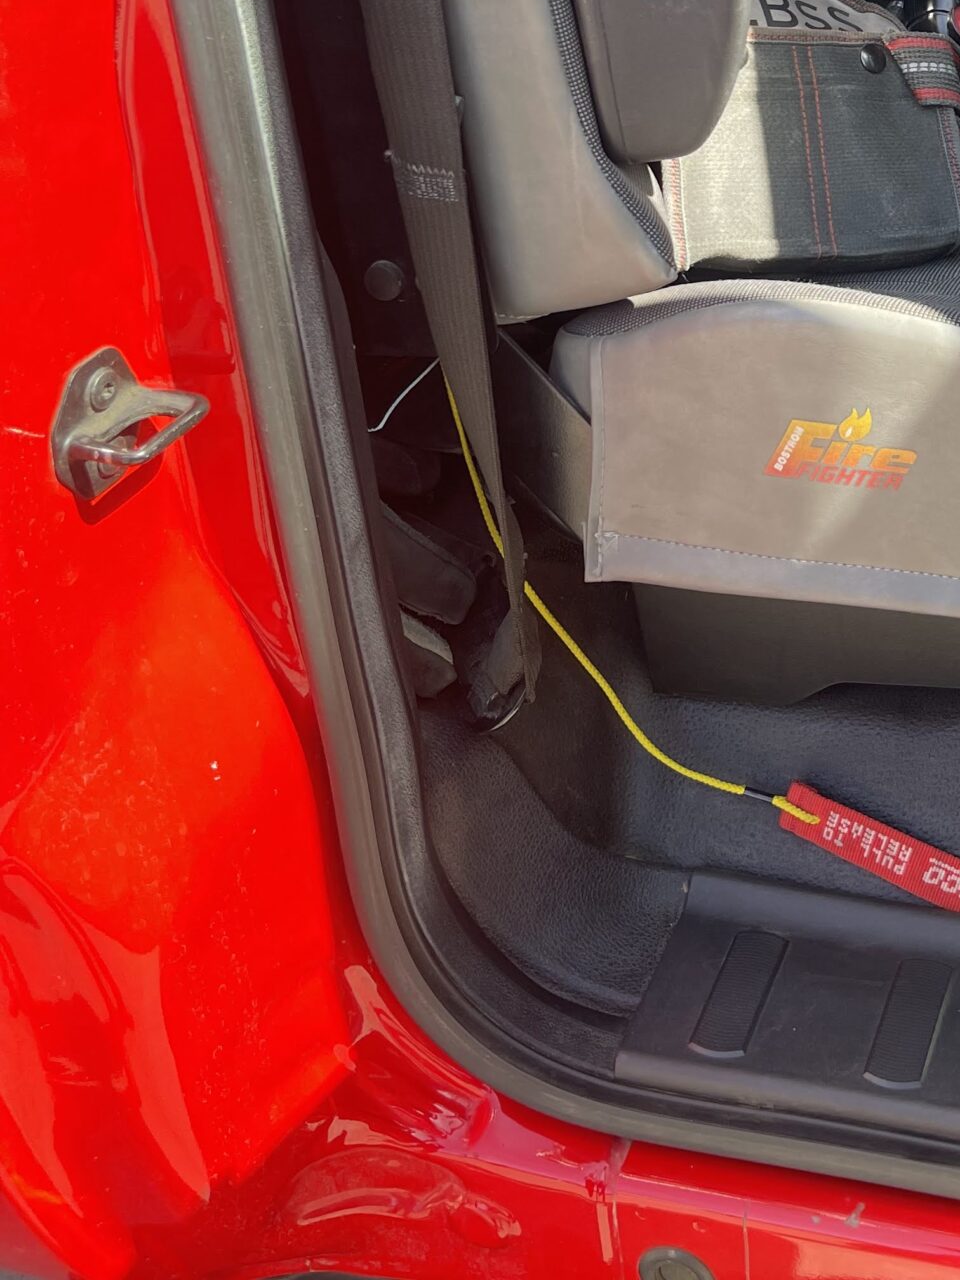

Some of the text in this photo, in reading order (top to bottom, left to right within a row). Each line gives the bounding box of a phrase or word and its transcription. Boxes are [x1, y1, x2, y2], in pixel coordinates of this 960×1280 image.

[763, 408, 918, 479] Fire
[773, 424, 805, 472] BOSTROM
[797, 464, 904, 491] FIGHTER
[822, 826, 906, 876] PULL TO
[825, 810, 913, 862] RELEASE
